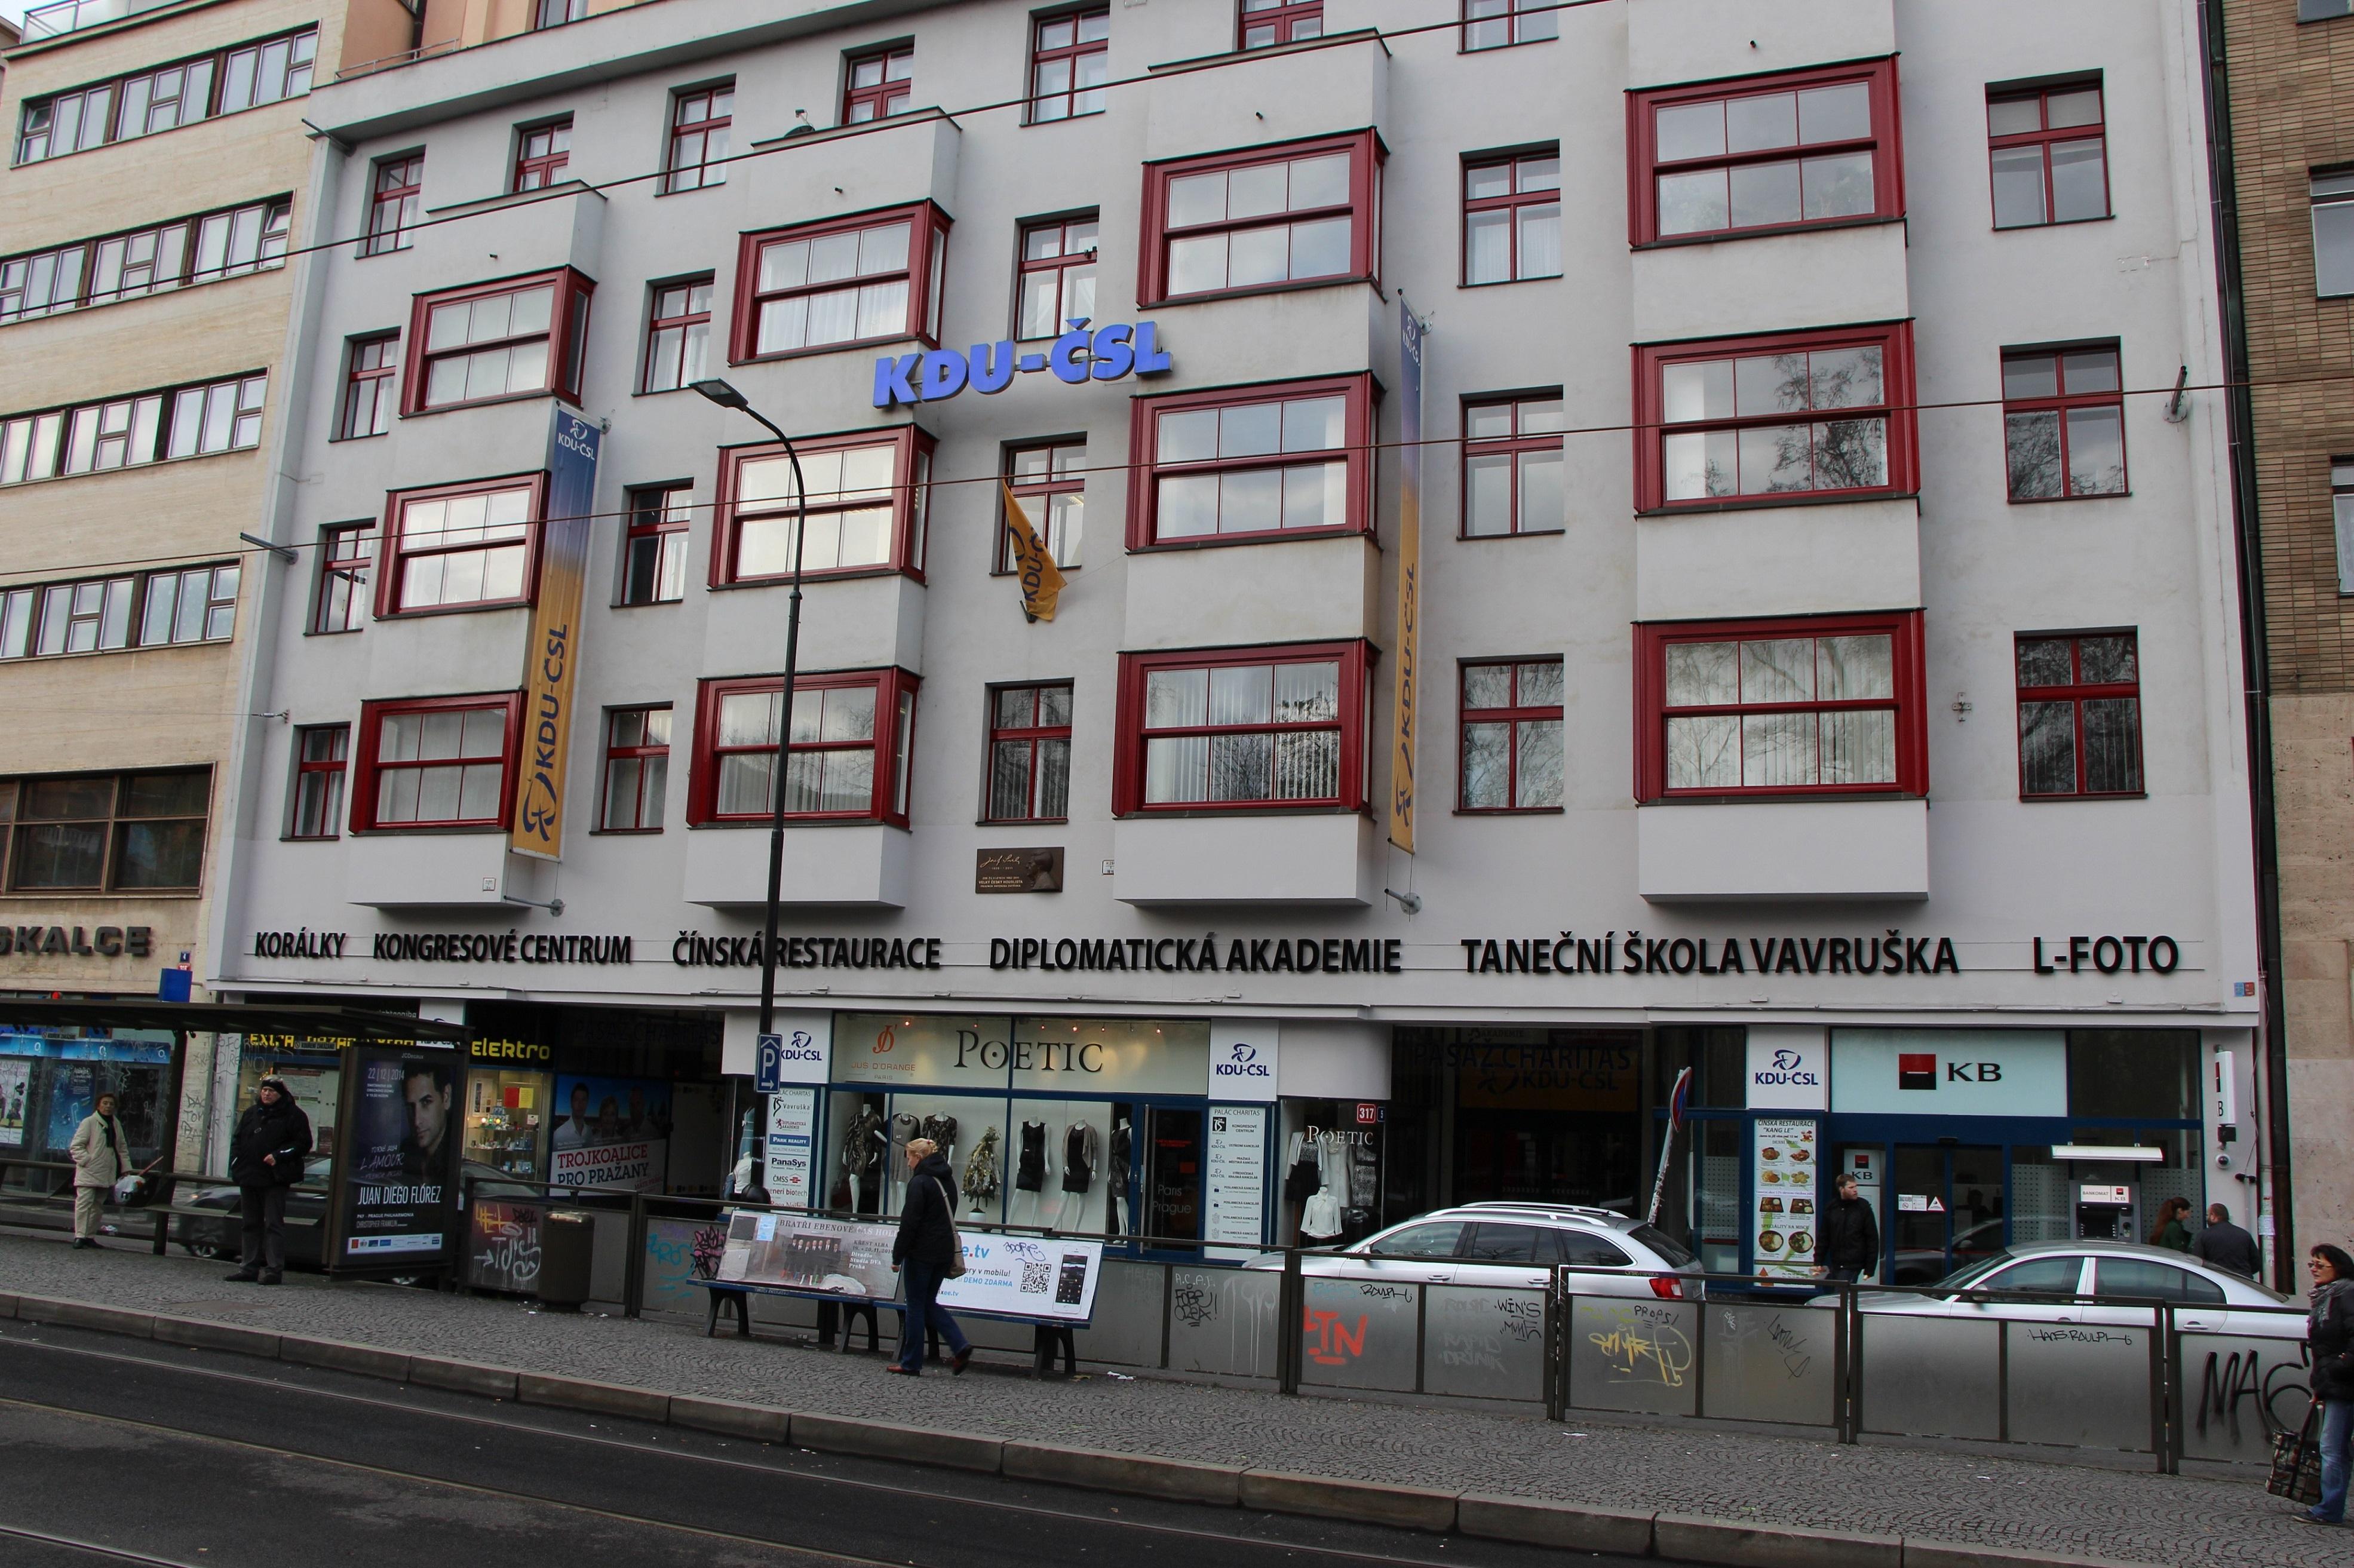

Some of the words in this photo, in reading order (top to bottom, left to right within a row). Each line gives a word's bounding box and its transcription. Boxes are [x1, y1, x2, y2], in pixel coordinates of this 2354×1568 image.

[873, 317, 1173, 408] KDU-ČSL
[557, 431, 595, 461] KDU-ČSL
[1401, 561, 1415, 738] KDU-ČSL
[536, 624, 567, 769] KDU-ČSL
[254, 926, 346, 959] KORÁLKY
[373, 929, 515, 963] KONGRESOVÉ
[520, 935, 631, 964] CENTRUM
[673, 930, 765, 967] ČÍNSKÁ
[776, 937, 941, 968] RESTAURACE
[990, 932, 1217, 971] DIPLOMATICKÁ
[1226, 938, 1401, 973] AKADEMIE
[1461, 931, 1615, 974] TANEČNÍ
[1622, 931, 1745, 974] ŠKOLA
[1750, 930, 1959, 974] VAVRUŠKA
[2033, 935, 2179, 974] L-FOTO
[781, 1050, 822, 1061] KDU-ČSL
[954, 1029, 1104, 1073] POETIC
[1414, 1038, 1497, 1069] PASÁŽ
[1501, 1044, 1632, 1071] CHARITAS
[762, 1048, 775, 1078] P
[872, 1063, 916, 1072] D'ORANGE
[1216, 1064, 1270, 1076] KDU-ČSL
[1947, 1061, 2002, 1082] KB
[1755, 1072, 1819, 1085] KDU-ČSL
[1359, 1107, 1374, 1119] 317
[1307, 1125, 1374, 1146] POETIC
[557, 1144, 648, 1168] TROJKOALICE
[772, 1158, 807, 1168] PanaSys
[557, 1170, 585, 1186] PRO
[588, 1162, 650, 1184] PRAŽANY
[773, 1174, 788, 1183] ČMSS
[1852, 1171, 1873, 1180] KB
[358, 1186, 381, 1205] JUAN
[383, 1186, 409, 1204] DIEGO
[410, 1183, 442, 1204] FLÓREZ
[785, 1188, 808, 1196] biotech
[1158, 1184, 1183, 1196] Paris
[1152, 1201, 1192, 1216] Prague
[779, 1219, 811, 1229] BRATŘI
[814, 1223, 854, 1233] EBENOVÉ
[857, 1226, 873, 1235] ČAS
[984, 1268, 1011, 1277] mobilu!
[984, 1278, 1013, 1287] ZDARMA
